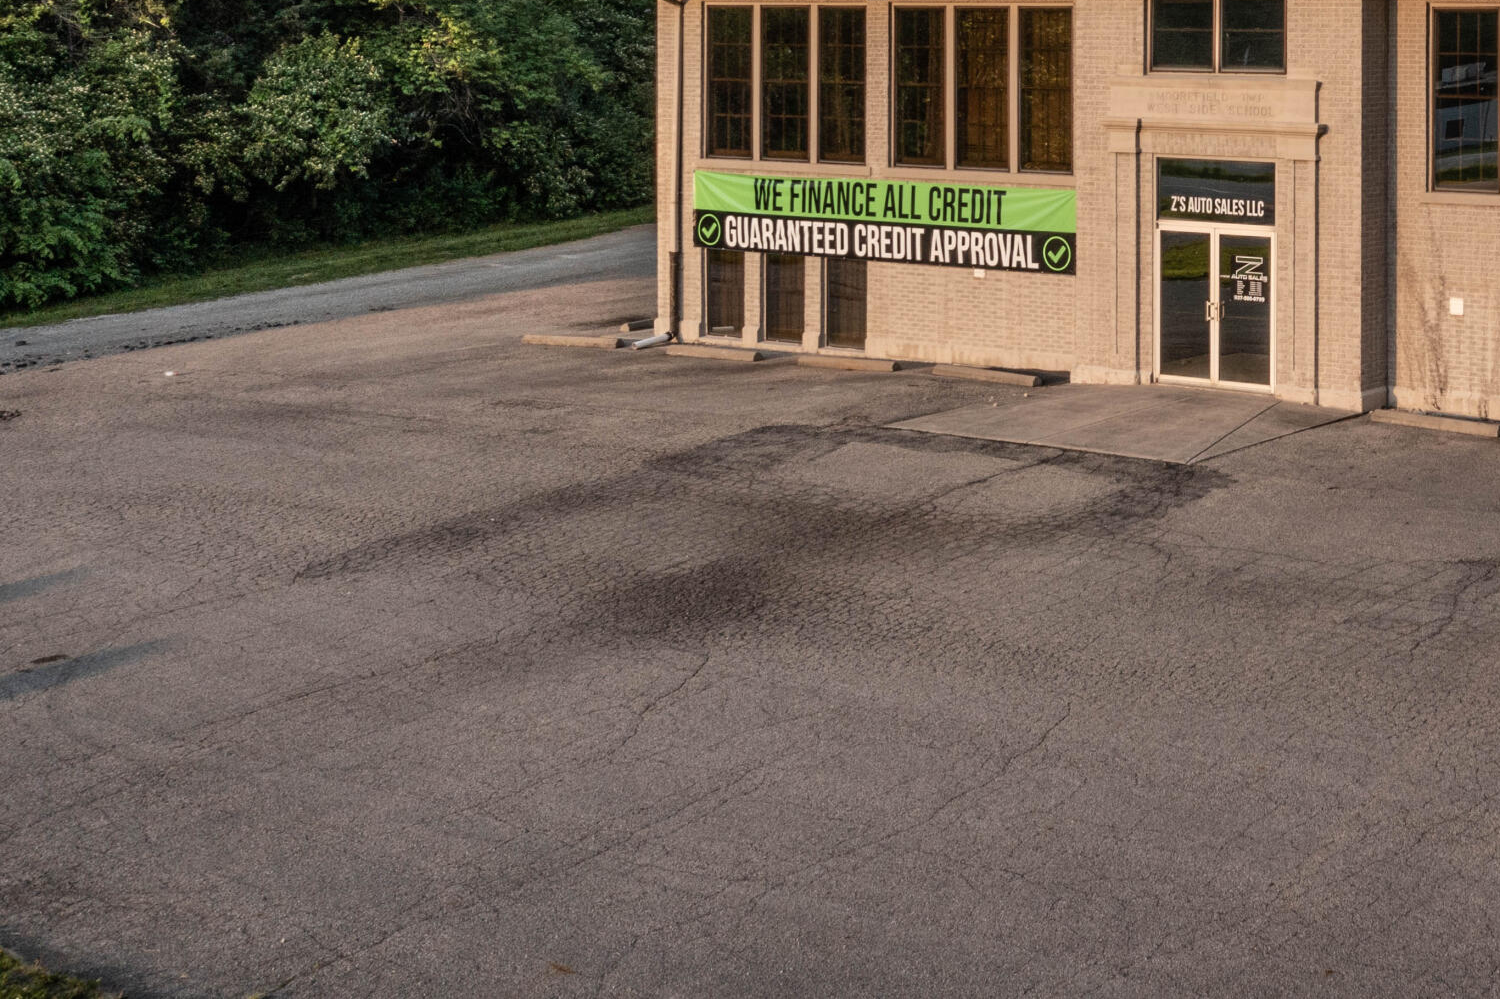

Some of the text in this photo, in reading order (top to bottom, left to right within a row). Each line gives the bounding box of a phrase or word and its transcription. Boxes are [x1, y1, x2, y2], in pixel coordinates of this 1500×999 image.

[1189, 104, 1217, 115] SIDE
[1227, 104, 1274, 117] SCHOOL
[753, 177, 1007, 226] WE FINANCE ALL CREDIT
[1170, 195, 1264, 217] Z'S AUTO SALES LLC
[724, 215, 1039, 270] GUARANTEED CREDIT APPROVAL
